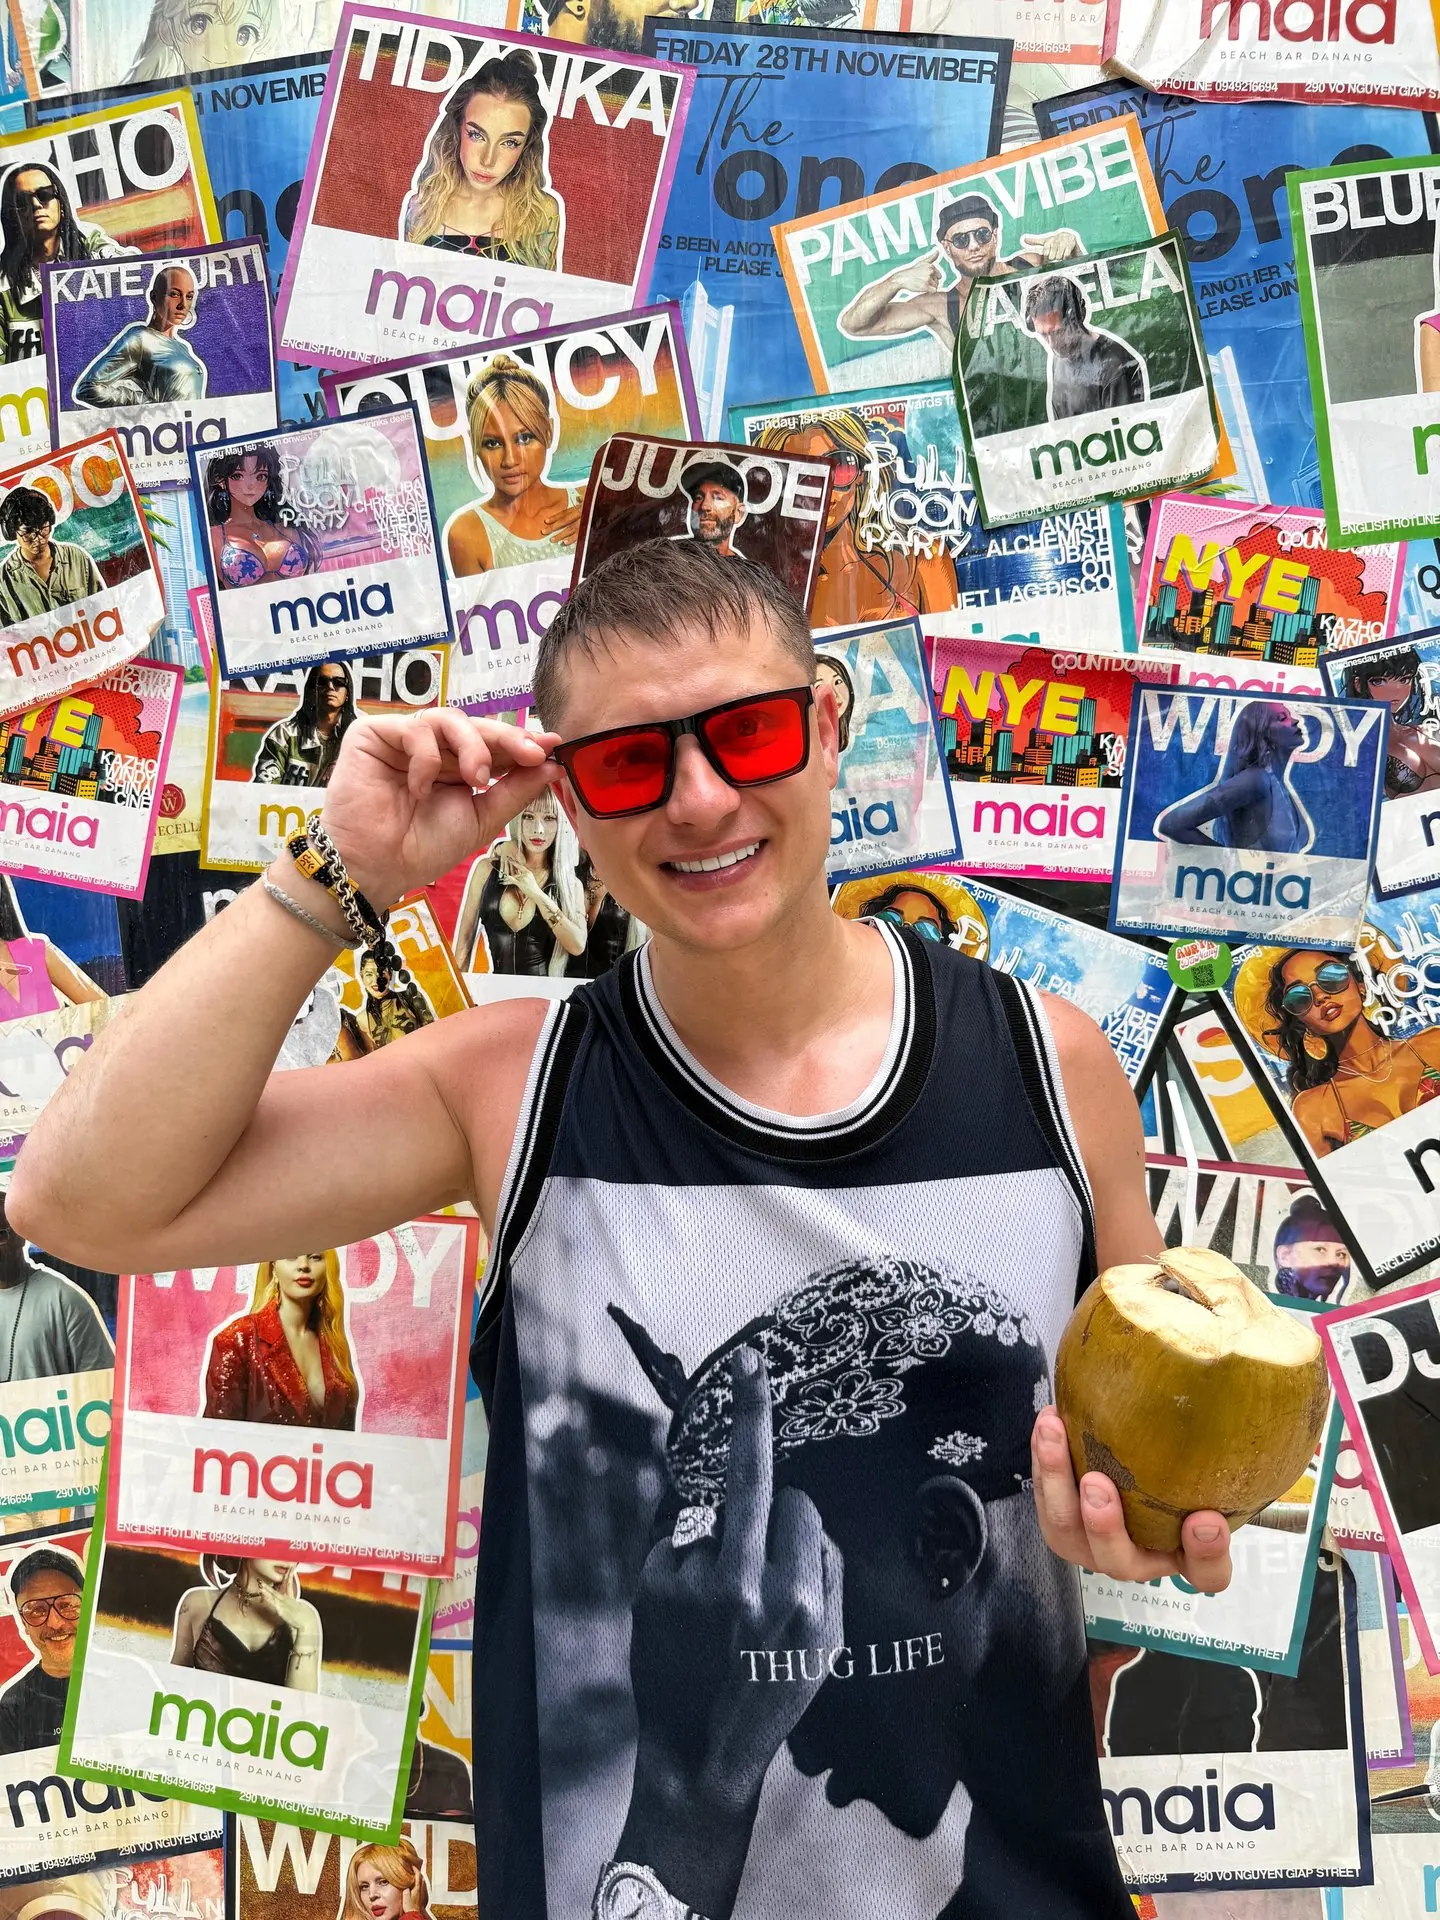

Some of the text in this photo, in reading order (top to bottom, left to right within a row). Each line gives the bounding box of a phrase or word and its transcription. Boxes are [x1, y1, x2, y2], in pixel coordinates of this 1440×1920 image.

[1016, 11, 1062, 23] BEACH
[654, 36, 998, 85] FRIDAY 28TH NOVEMBER
[1220, 51, 1374, 63] BEACH BAR DANANG
[1164, 79, 1212, 92] HOTLINE
[1216, 80, 1278, 94] 0949216694
[1305, 83, 1426, 98] 290 VO NGUYEN GIAP
[695, 72, 794, 176] The
[984, 138, 1138, 220] VIBE
[676, 236, 720, 253] BEEN
[704, 256, 771, 277] PLEASE
[51, 262, 144, 304] KATE
[1200, 263, 1282, 299] ANOTHER
[383, 327, 426, 344] BEACH
[748, 418, 796, 433] Sunday
[856, 404, 885, 421] 3pm
[887, 397, 943, 415] onwards
[263, 439, 282, 451] 3pm
[1029, 417, 1163, 481] maia
[863, 440, 975, 493] FULL
[1052, 461, 1153, 489] BEACH BAR DANANG
[354, 491, 427, 513] CHRISTIAN
[373, 502, 429, 520] MAGGIE
[858, 489, 979, 532] MOON
[278, 508, 350, 531] PARTY
[1341, 517, 1392, 536] ENGLISH
[381, 534, 434, 553] QUINCY
[859, 522, 973, 560] PARTY
[1161, 532, 1311, 616] NYE
[1041, 574, 1115, 600] DISCO
[270, 578, 394, 634] maia
[290, 622, 384, 645] BEACH BAR DANANG
[1321, 614, 1386, 639] KAZHO
[8, 606, 125, 677] maia
[1379, 645, 1397, 661] April
[1417, 639, 1434, 651] 3pm
[488, 653, 531, 670] BEACH
[941, 665, 1086, 737] NYE
[100, 750, 157, 771] KAZHO
[104, 778, 152, 797] SHINA
[114, 791, 150, 809] CINE
[973, 794, 1105, 838] maia
[44, 846, 81, 858] DANANG
[988, 839, 1089, 850] BEACH BAR DANANG
[875, 848, 957, 871] NGUYEN STREET
[950, 859, 983, 870] HOTLINE
[1070, 866, 1103, 876] NGUYEN
[1175, 862, 1312, 910] maia
[942, 875, 961, 889] 3rd
[970, 884, 996, 905] 3pm
[998, 900, 1048, 924] onwards
[1190, 905, 1294, 921] BEACH BAR DANANG
[1115, 919, 1184, 933] ENGLISH HOTLINE
[1274, 933, 1309, 946] NGUYEN
[1375, 1245, 1421, 1277] ENGLISH
[24, 1461, 48, 1474] BAR
[193, 1443, 374, 1509] maia
[56, 1486, 90, 1499] 290 VO
[213, 1503, 352, 1525] BEACH BAR DANANG
[117, 1522, 266, 1547] ENGLISH HOTLINE 0949216694
[289, 1539, 444, 1564] 290 VO NGUYEN GIAP STREET
[1097, 1586, 1192, 1612] BAR DANANG
[1121, 1620, 1288, 1661] 290 VO NGUYEN GIAP STREET
[740, 1632, 946, 1683] THUG LIFE
[150, 1691, 329, 1771] maia
[70, 1756, 217, 1795] ENGLISH HOTLINE 0949216694
[168, 1748, 303, 1784] BEACH BAR DANANG
[239, 1791, 391, 1832] 290 VO NGUYEN GIAP STREET
[1102, 1768, 1276, 1836] maia
[38, 1810, 170, 1842] BEACH BAR DANANG
[119, 1829, 224, 1857] 290 VO NGUYEN GIAP
[1161, 1840, 1257, 1853] BAR DANANG
[42, 1852, 97, 1871] 0949216694
[1193, 1867, 1361, 1882] 290 VO NGUYEN GIAP STREET
